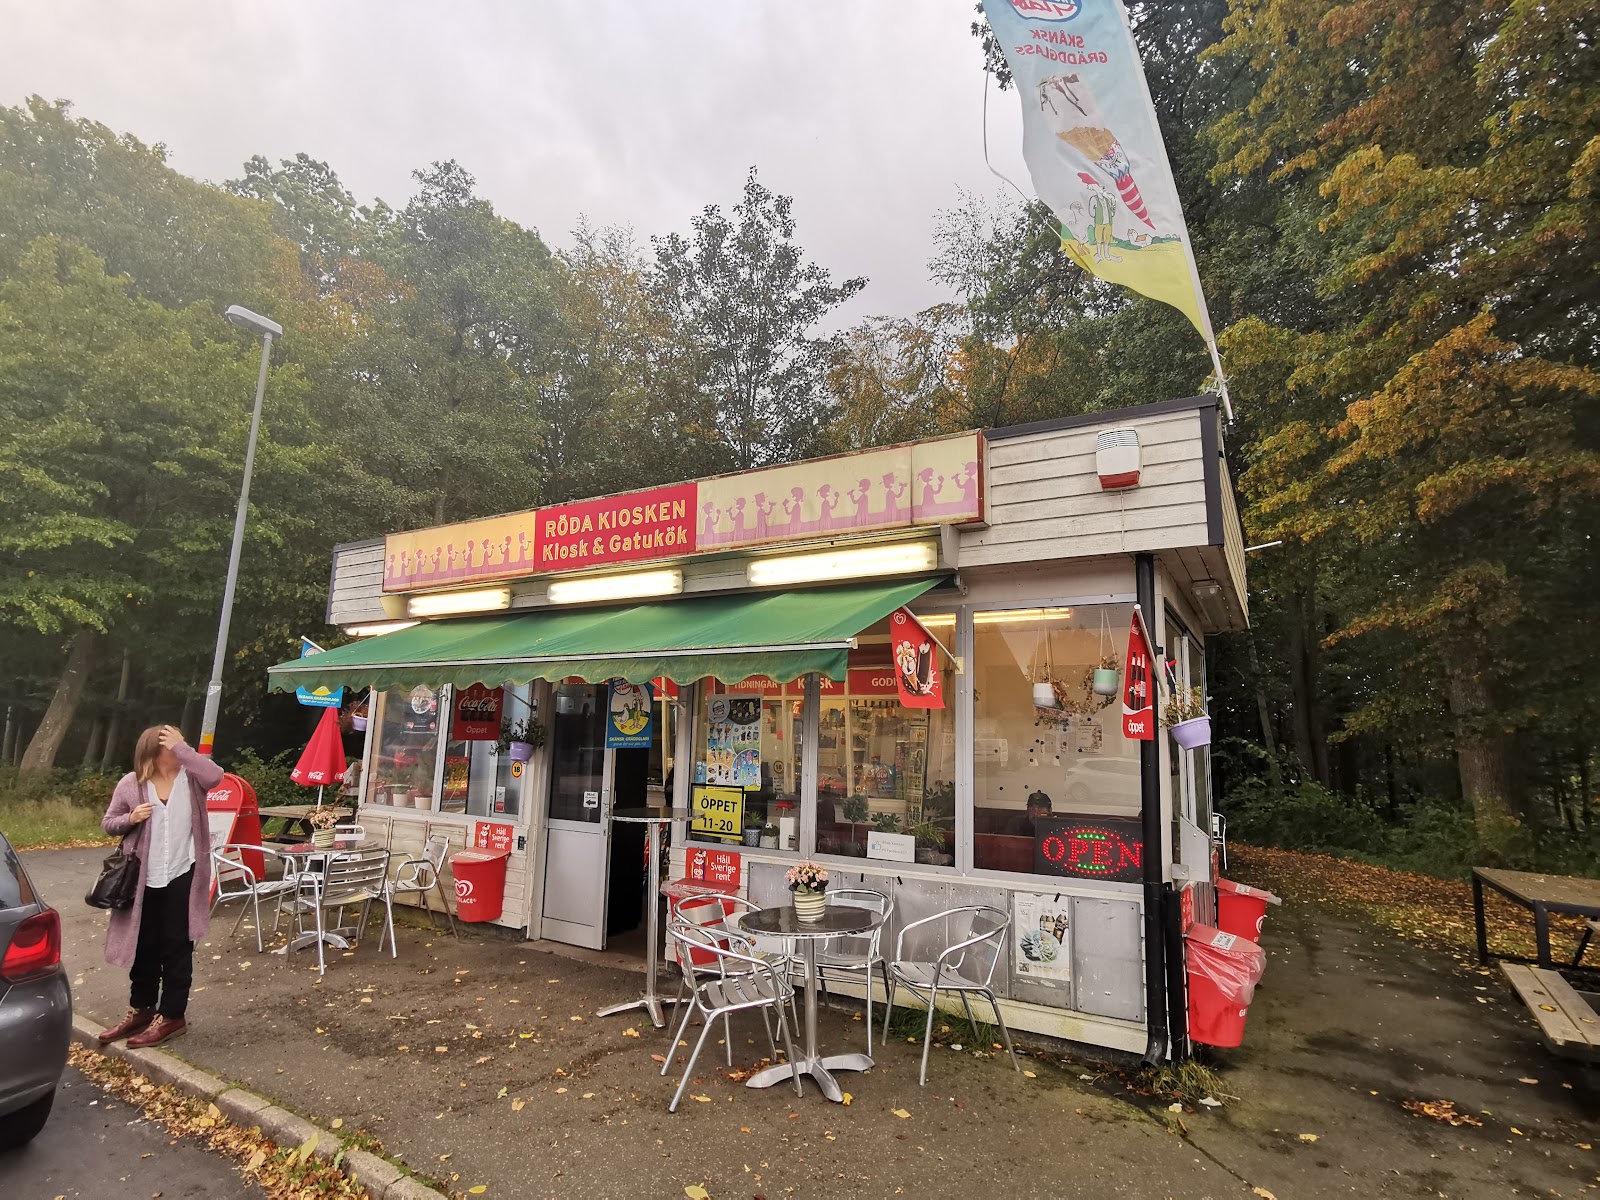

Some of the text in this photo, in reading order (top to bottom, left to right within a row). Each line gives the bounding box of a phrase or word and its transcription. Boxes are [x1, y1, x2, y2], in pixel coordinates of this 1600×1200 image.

[545, 499, 686, 538] RÖDA KIOSKEN
[542, 525, 688, 561] Kiosk & Gatukök
[797, 677, 833, 689] KSK
[872, 677, 898, 687] GODI
[466, 725, 488, 735] Öppet
[1128, 719, 1145, 734] öppet
[701, 795, 738, 813] ÖPPET
[702, 817, 733, 832] 11-20
[492, 833, 510, 843] Sverige
[1042, 836, 1144, 869] OPEN
[716, 854, 731, 865] Håll
[710, 862, 736, 875] Sverige
[715, 872, 731, 882] rent
